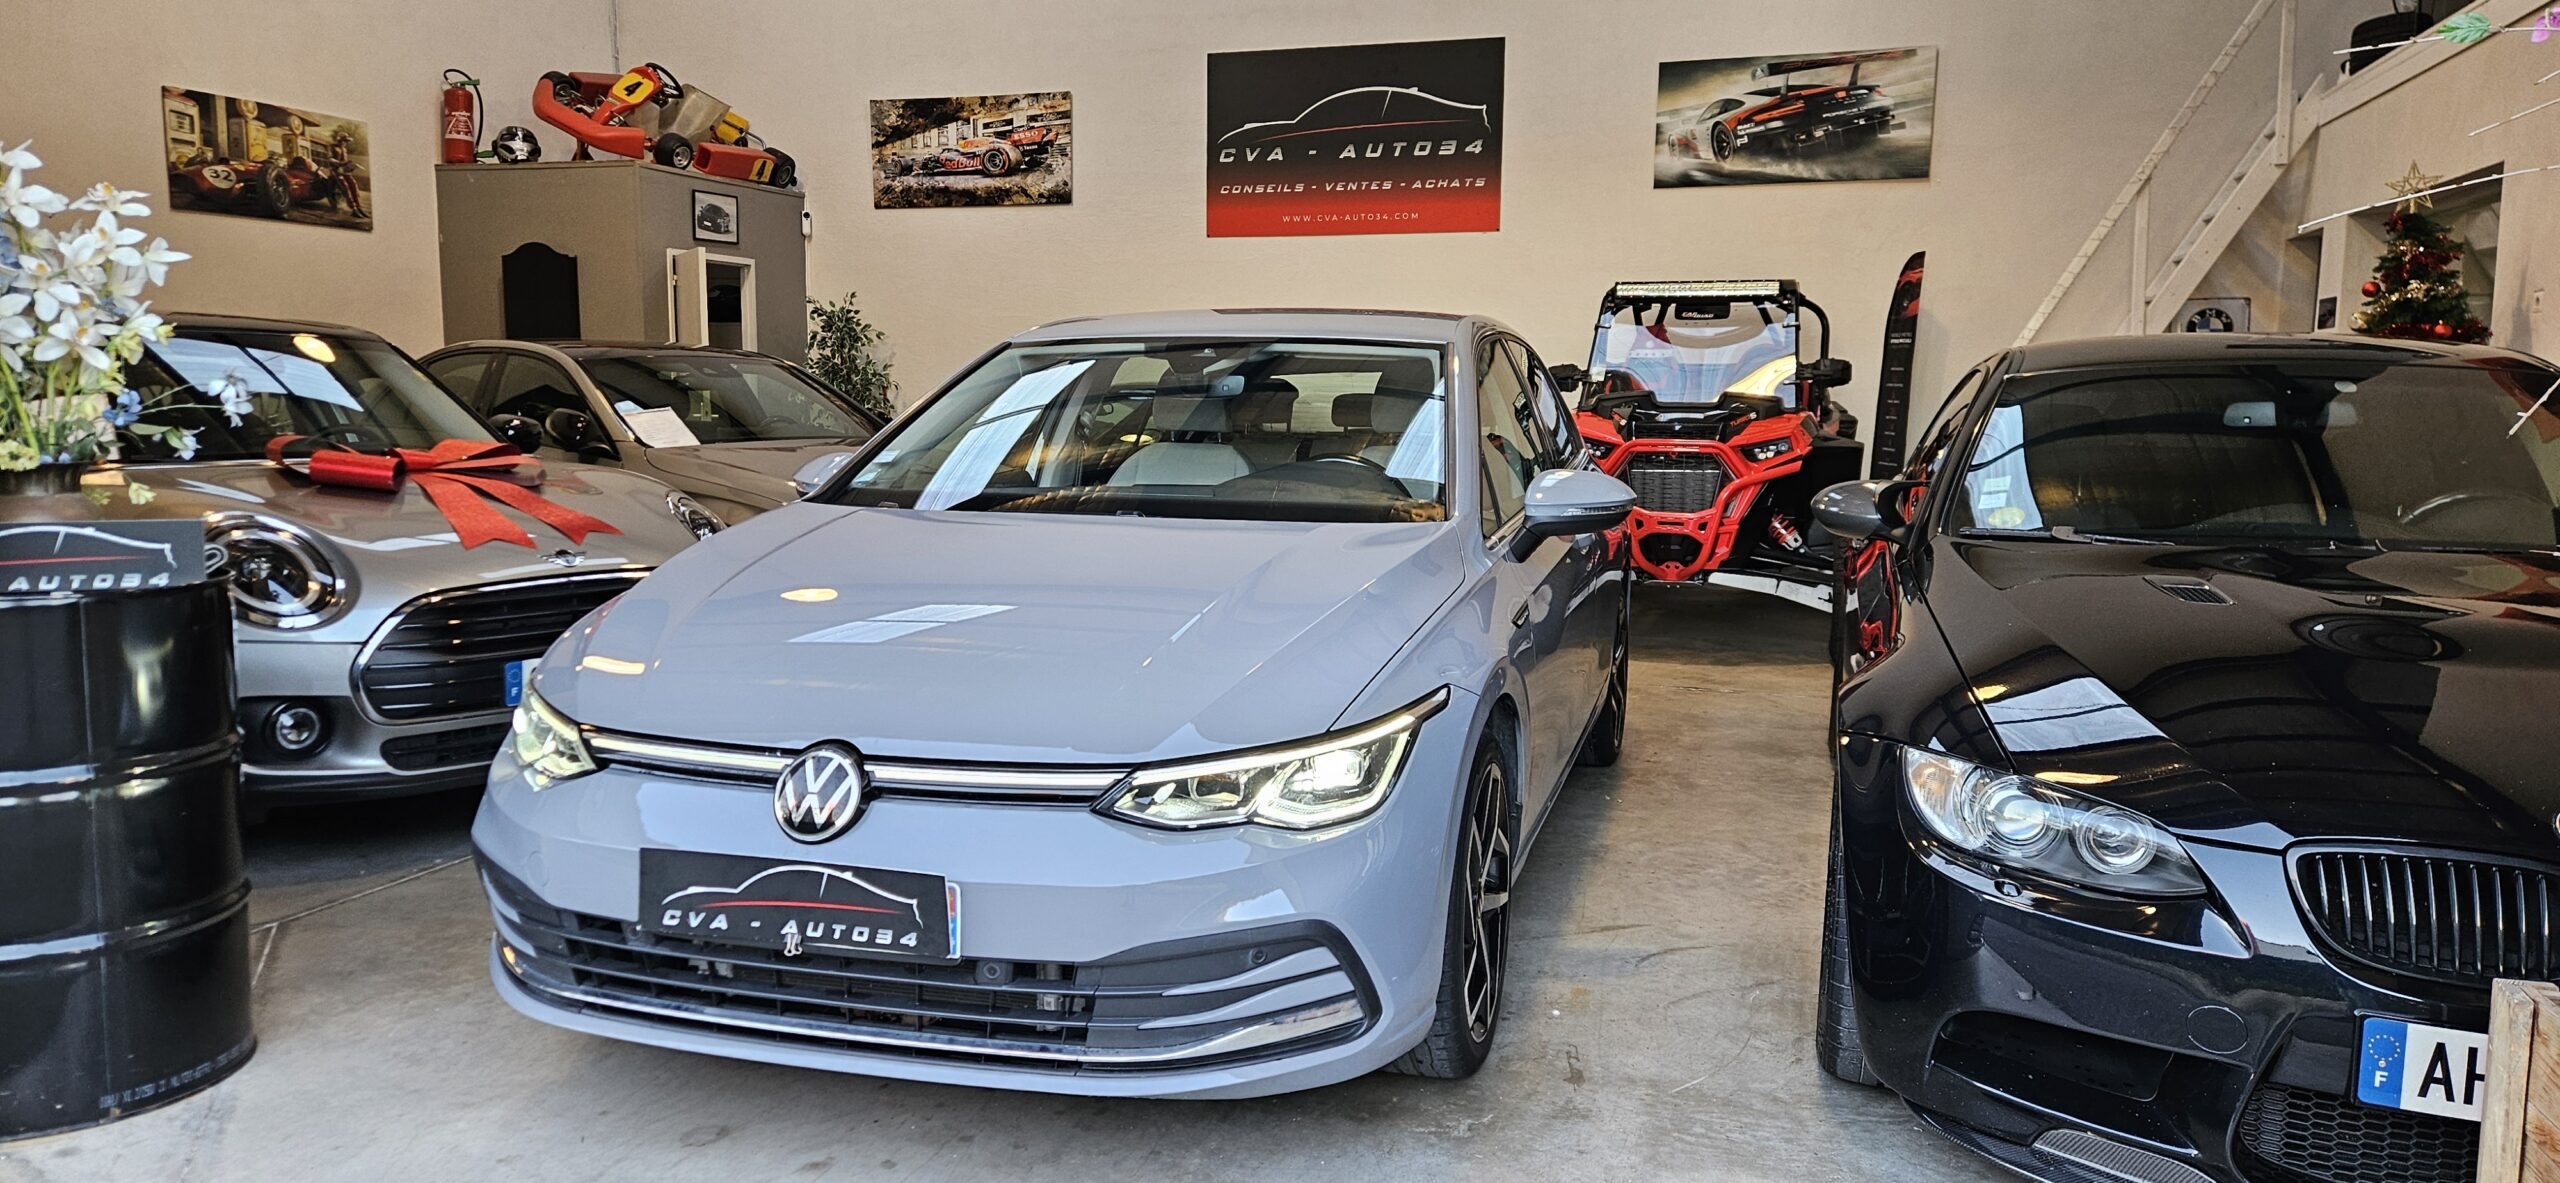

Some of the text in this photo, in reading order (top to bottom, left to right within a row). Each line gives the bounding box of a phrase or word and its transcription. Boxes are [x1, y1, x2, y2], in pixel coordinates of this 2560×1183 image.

[623, 81, 642, 97] 4
[1219, 147, 1284, 163] CVA
[1339, 139, 1484, 159] AUTO34
[209, 168, 234, 182] 32
[756, 160, 767, 180] 4
[1220, 183, 1305, 195] CONSEILS
[1325, 180, 1393, 191] VENTES
[1412, 178, 1487, 189] ACHATS
[1282, 212, 1420, 223] WWW.CVA-AUTO34.COM
[8, 572, 170, 592] AUTO34
[511, 687, 519, 697] F
[662, 909, 728, 930] CVA
[780, 919, 917, 947] AUTO34
[2374, 1070, 2389, 1088] F
